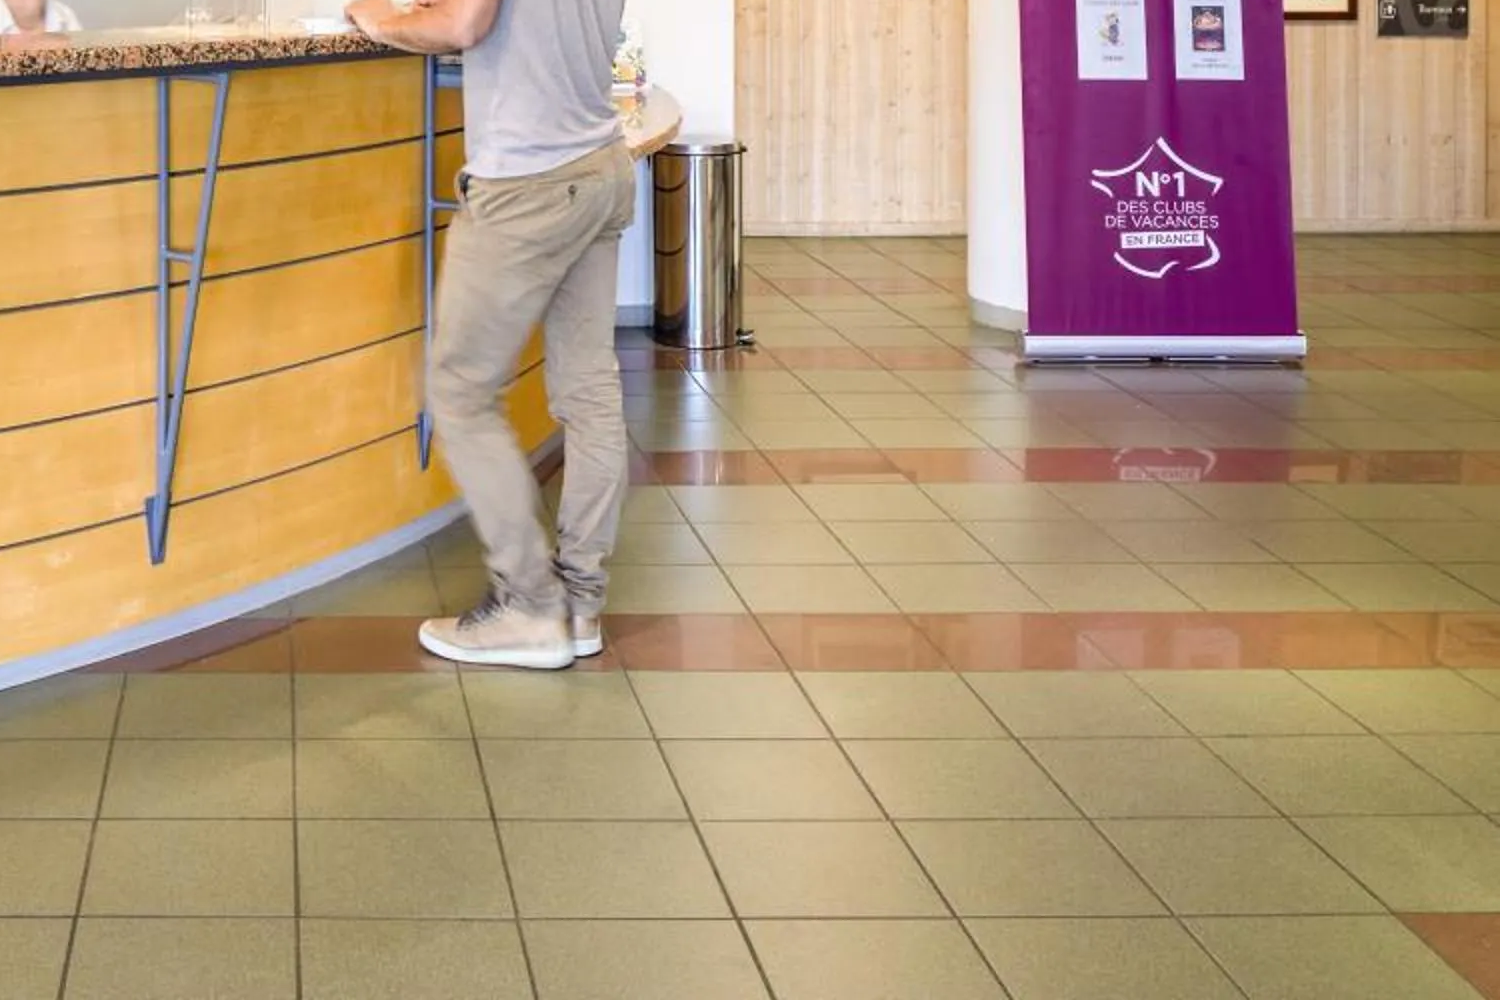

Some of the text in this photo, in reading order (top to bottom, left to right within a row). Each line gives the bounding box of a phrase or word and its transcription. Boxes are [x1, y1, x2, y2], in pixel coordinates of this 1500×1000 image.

[1135, 171, 1185, 197] N°1
[1117, 200, 1206, 214] DES CLUBS
[1105, 215, 1219, 229] DE VACANCES
[1126, 233, 1200, 246] EN FRANCE
